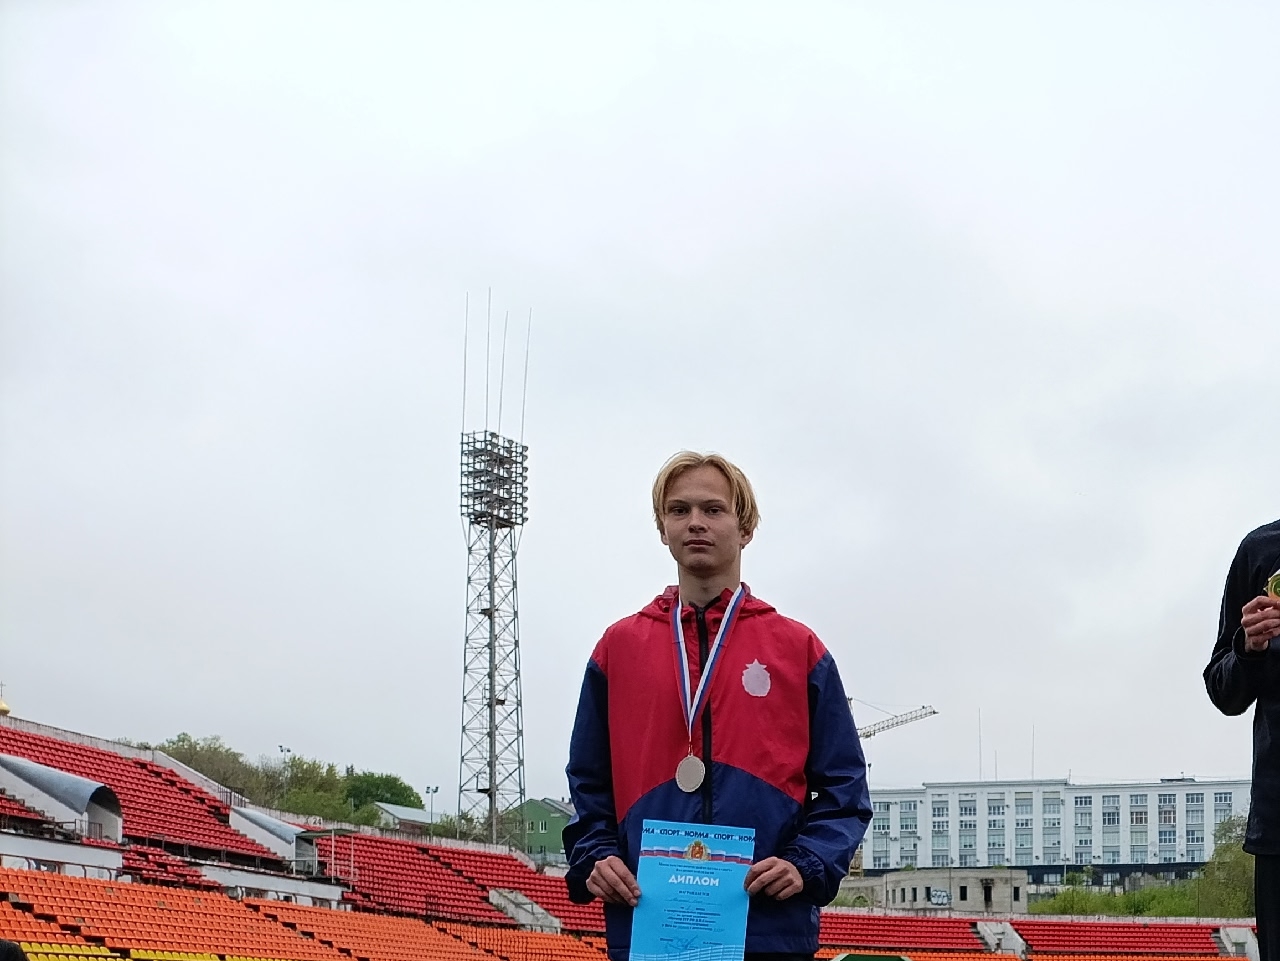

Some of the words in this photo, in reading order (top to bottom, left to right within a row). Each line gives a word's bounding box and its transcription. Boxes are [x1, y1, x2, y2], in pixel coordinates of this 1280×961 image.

[659, 828, 680, 837] СПОРТ
[684, 830, 709, 839] НОРМА
[713, 832, 735, 841] СПОРТ
[668, 874, 720, 887] ДИПЛОМ
